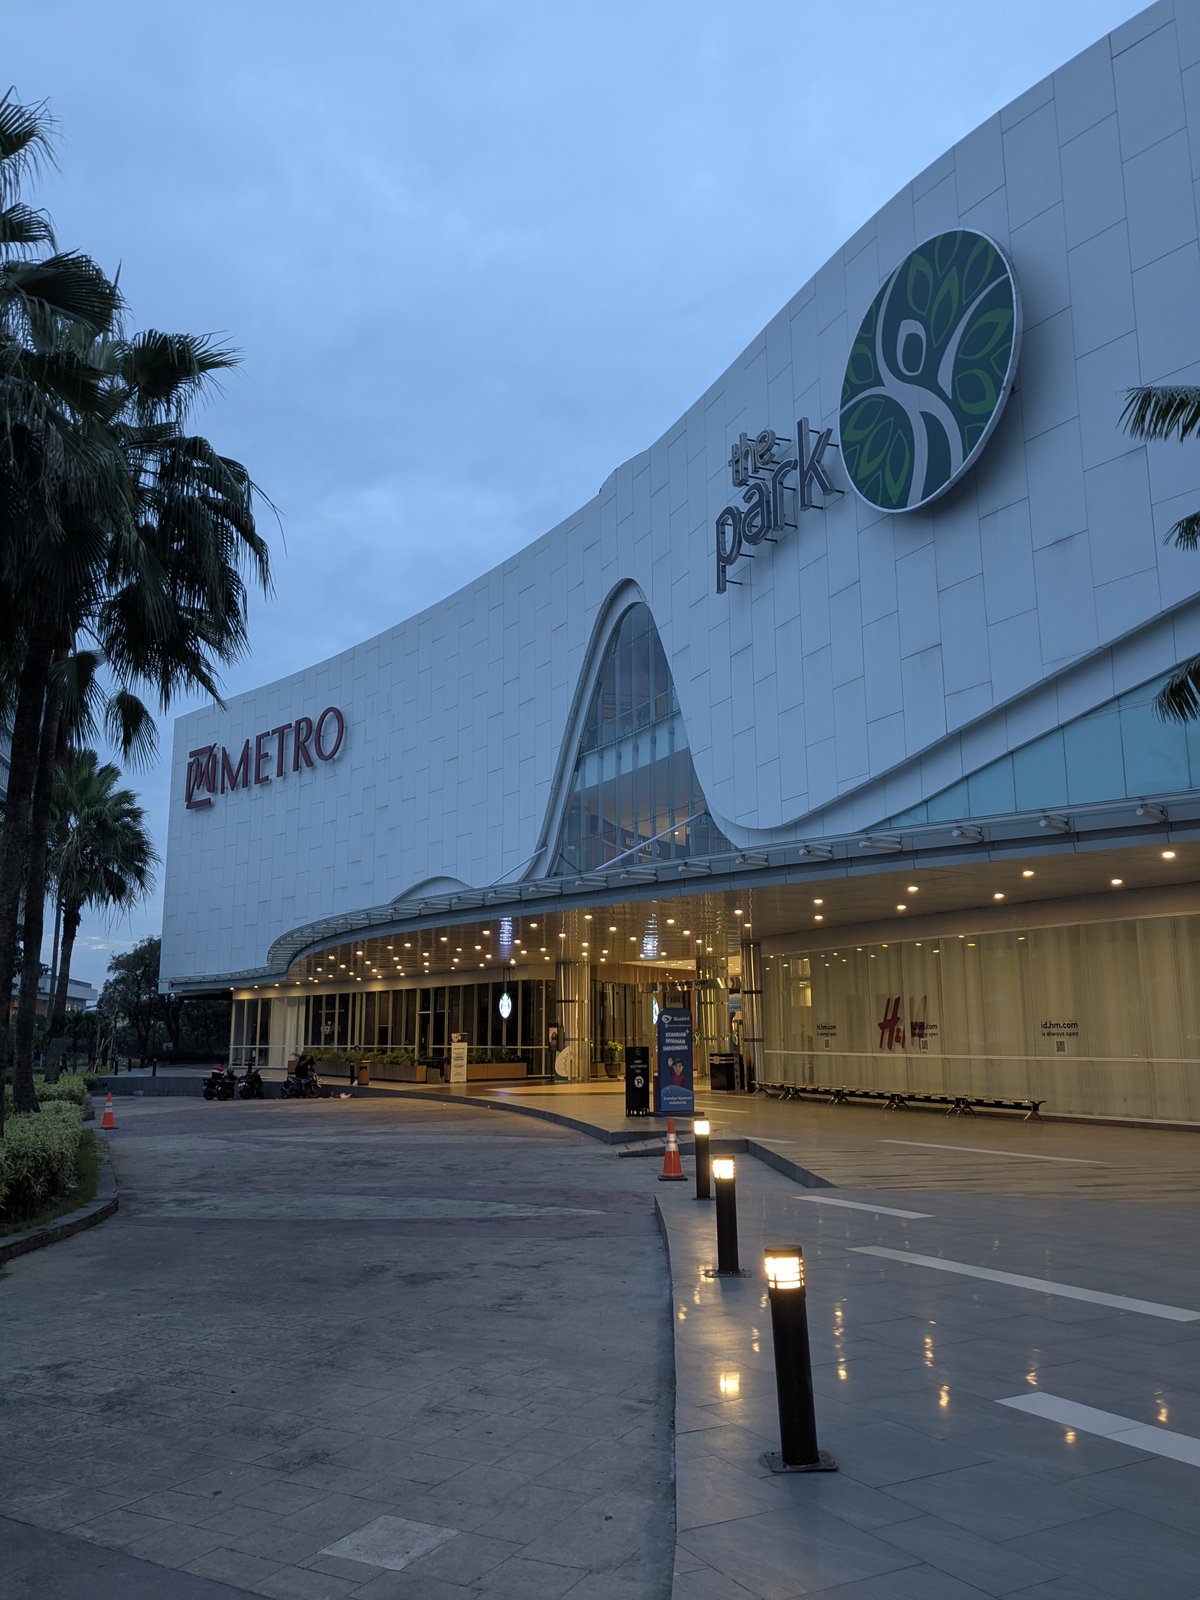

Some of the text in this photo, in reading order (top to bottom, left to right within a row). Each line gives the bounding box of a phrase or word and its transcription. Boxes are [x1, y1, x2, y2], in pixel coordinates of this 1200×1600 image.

[728, 429, 776, 487] the
[716, 416, 835, 594] park
[220, 706, 345, 795] METRO
